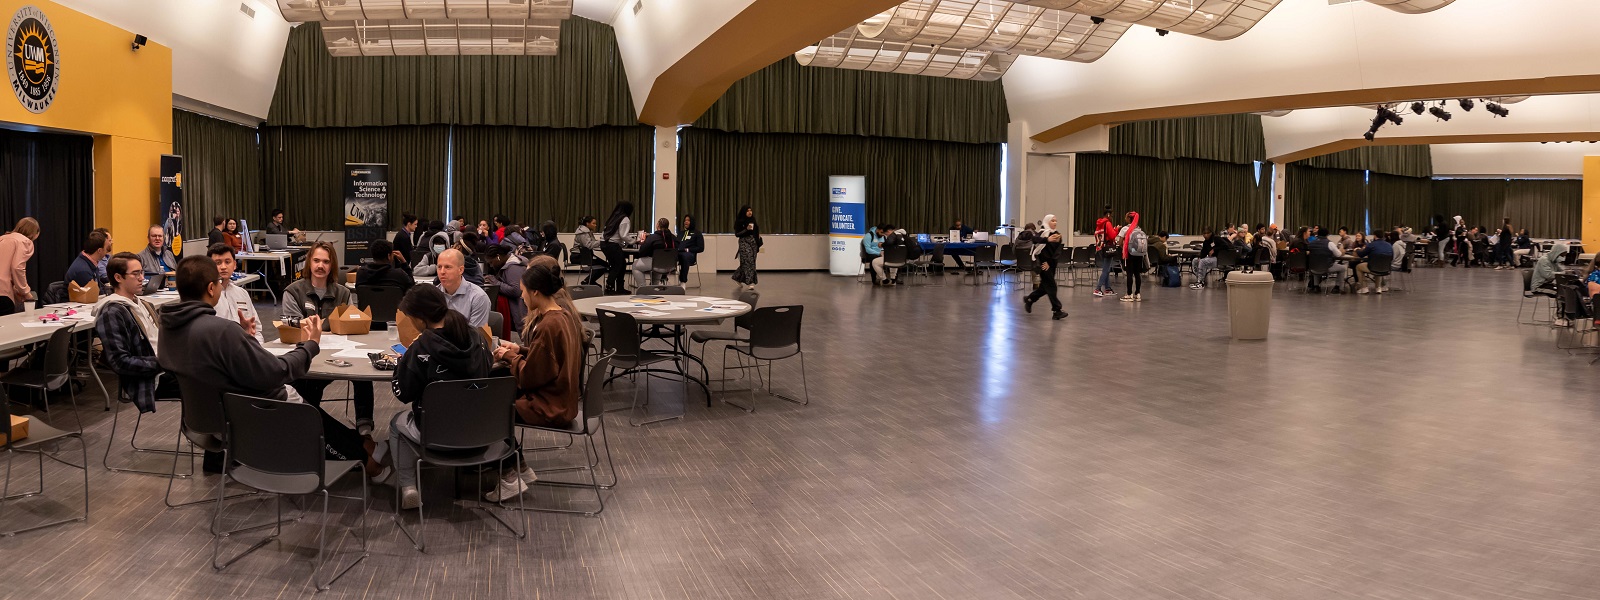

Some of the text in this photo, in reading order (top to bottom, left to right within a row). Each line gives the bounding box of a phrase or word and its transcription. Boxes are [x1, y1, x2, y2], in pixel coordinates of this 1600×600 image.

[8, 6, 32, 70] UNIVERSITY
[38, 11, 60, 81] WISCONSIN
[24, 43, 44, 62] UWM
[12, 79, 56, 111] MILWAUKEE
[354, 191, 387, 199] Technology
